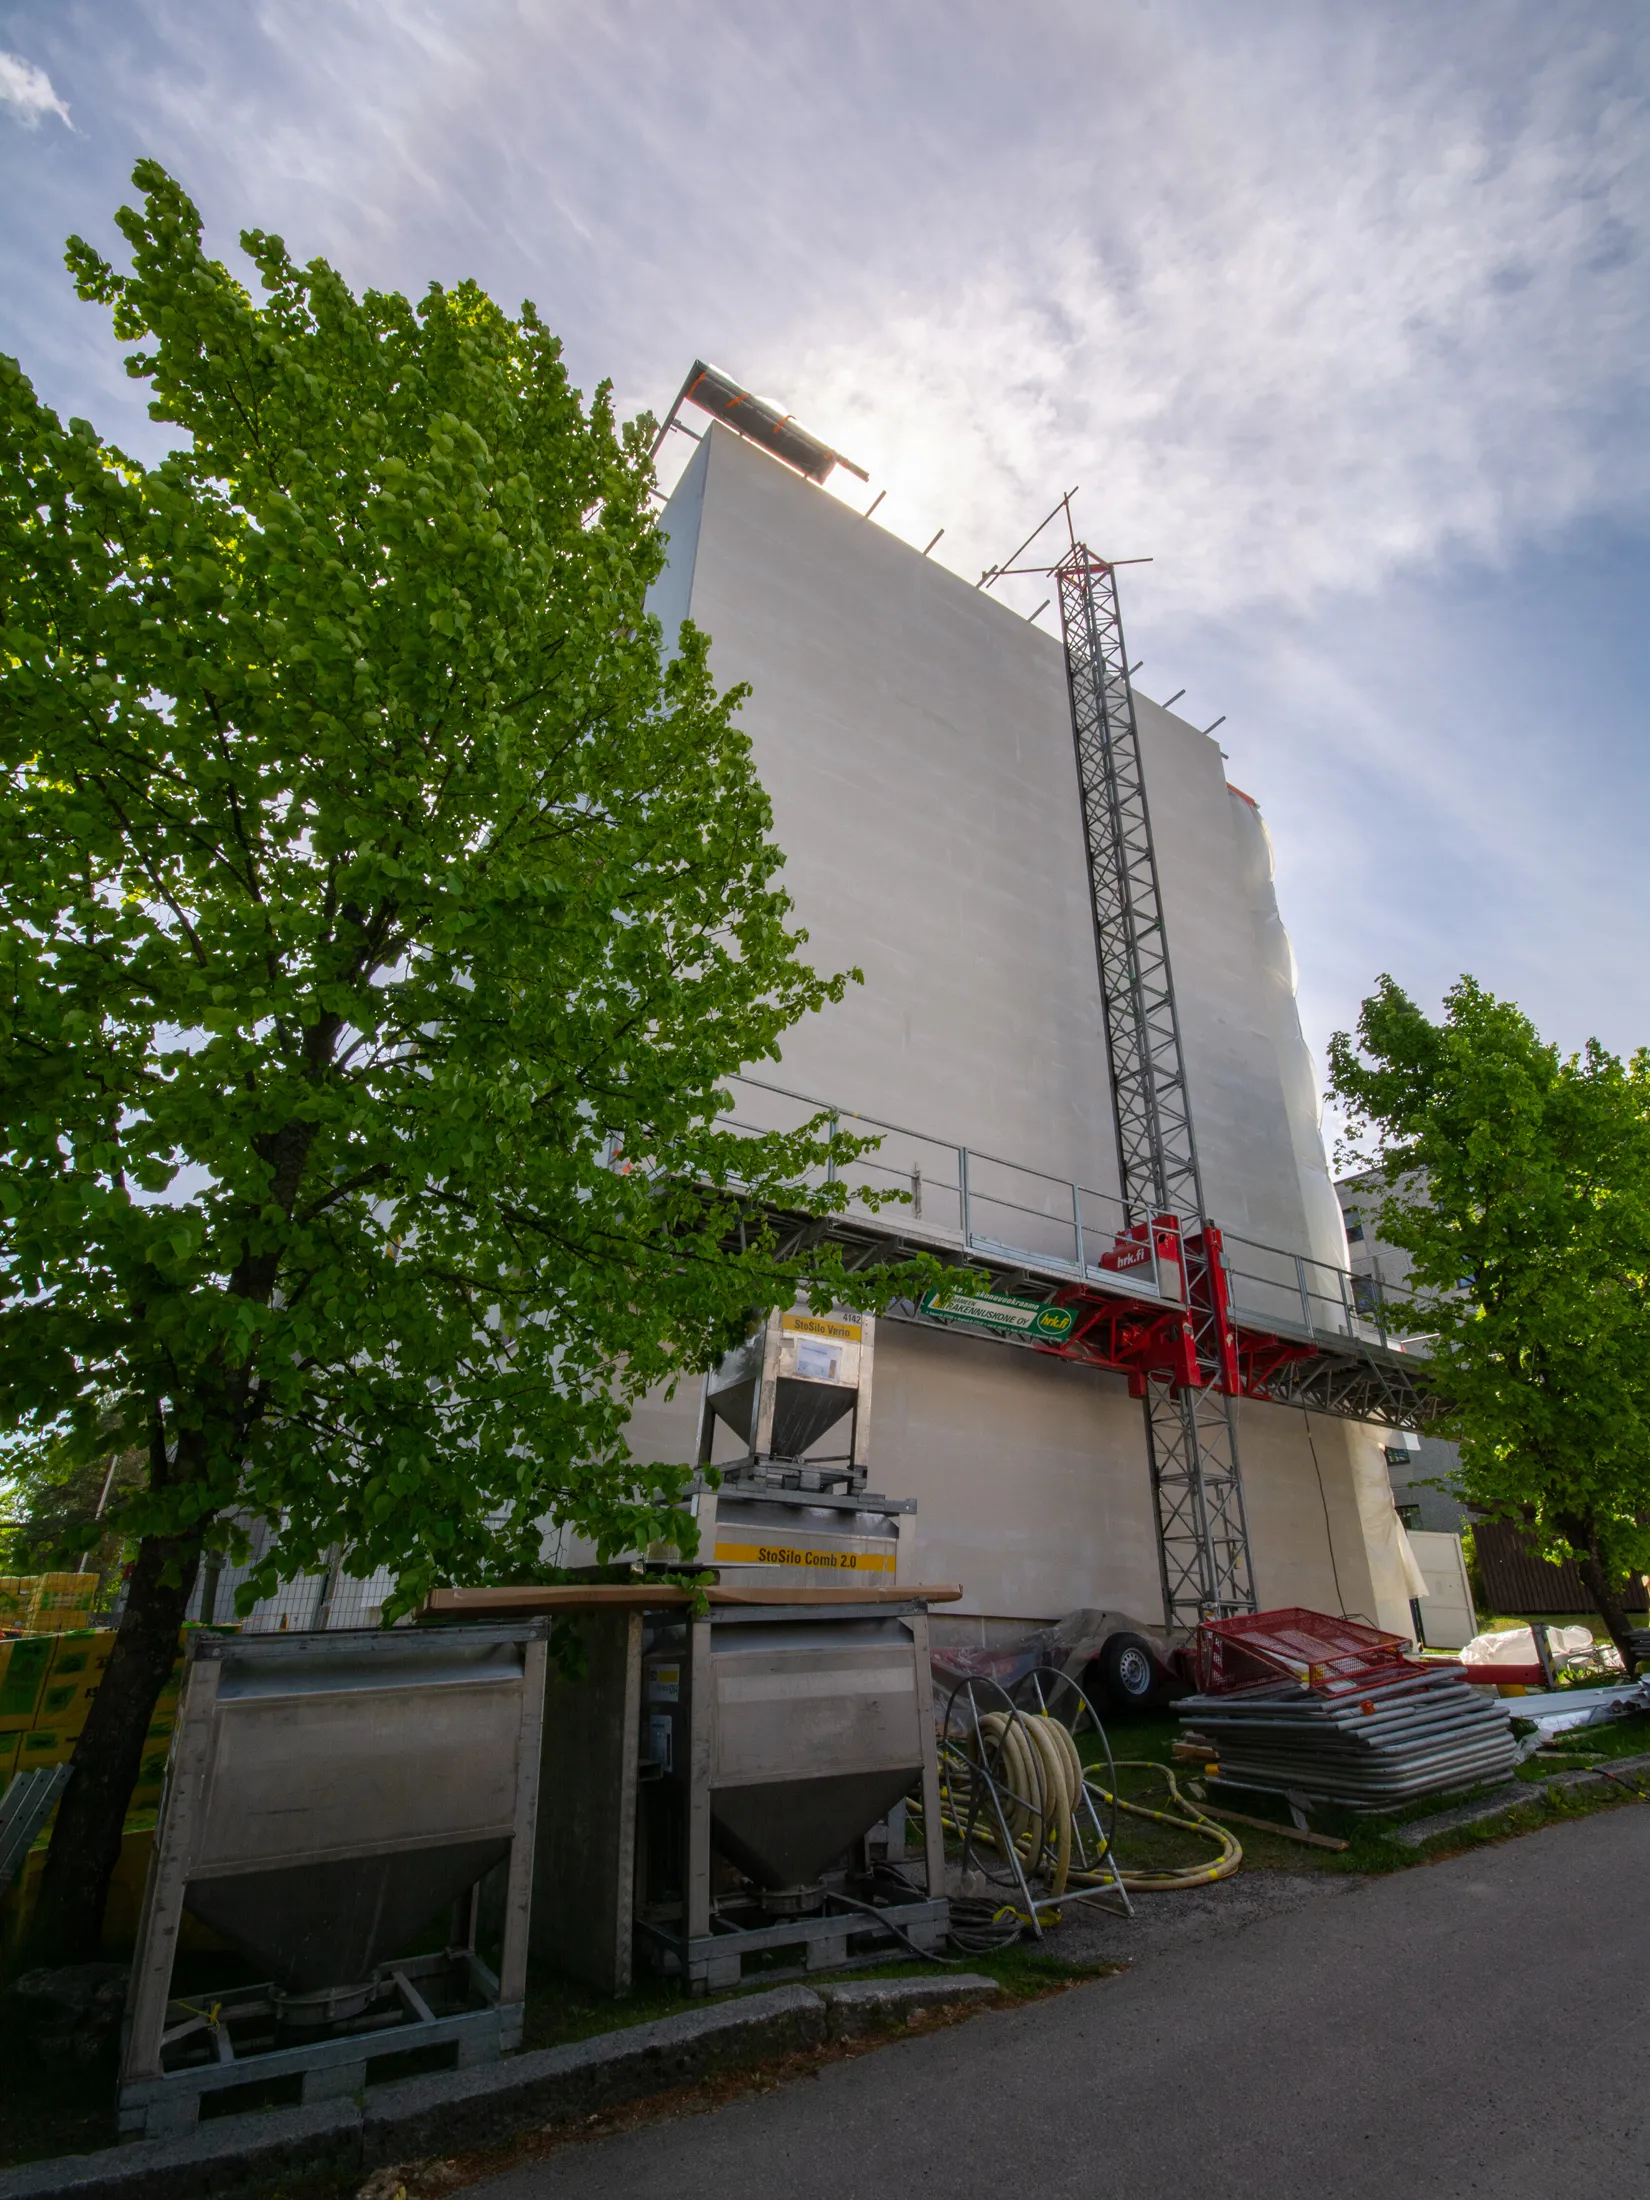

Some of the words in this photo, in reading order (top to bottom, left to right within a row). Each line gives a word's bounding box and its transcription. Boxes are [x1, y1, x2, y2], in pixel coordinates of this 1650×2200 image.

[1117, 1248, 1145, 1268] hrk.fi
[843, 1313, 861, 1324] 4142
[946, 1303, 1017, 1324] RAKENNUSKONE
[1016, 1317, 1030, 1325] OY
[1040, 1313, 1070, 1329] hrk.fi
[794, 1319, 825, 1334] StoSilo
[828, 1325, 851, 1337] Vario
[758, 1548, 801, 1565] StoSilo
[805, 1551, 837, 1567] Comb
[840, 1554, 857, 1568] 2.0
